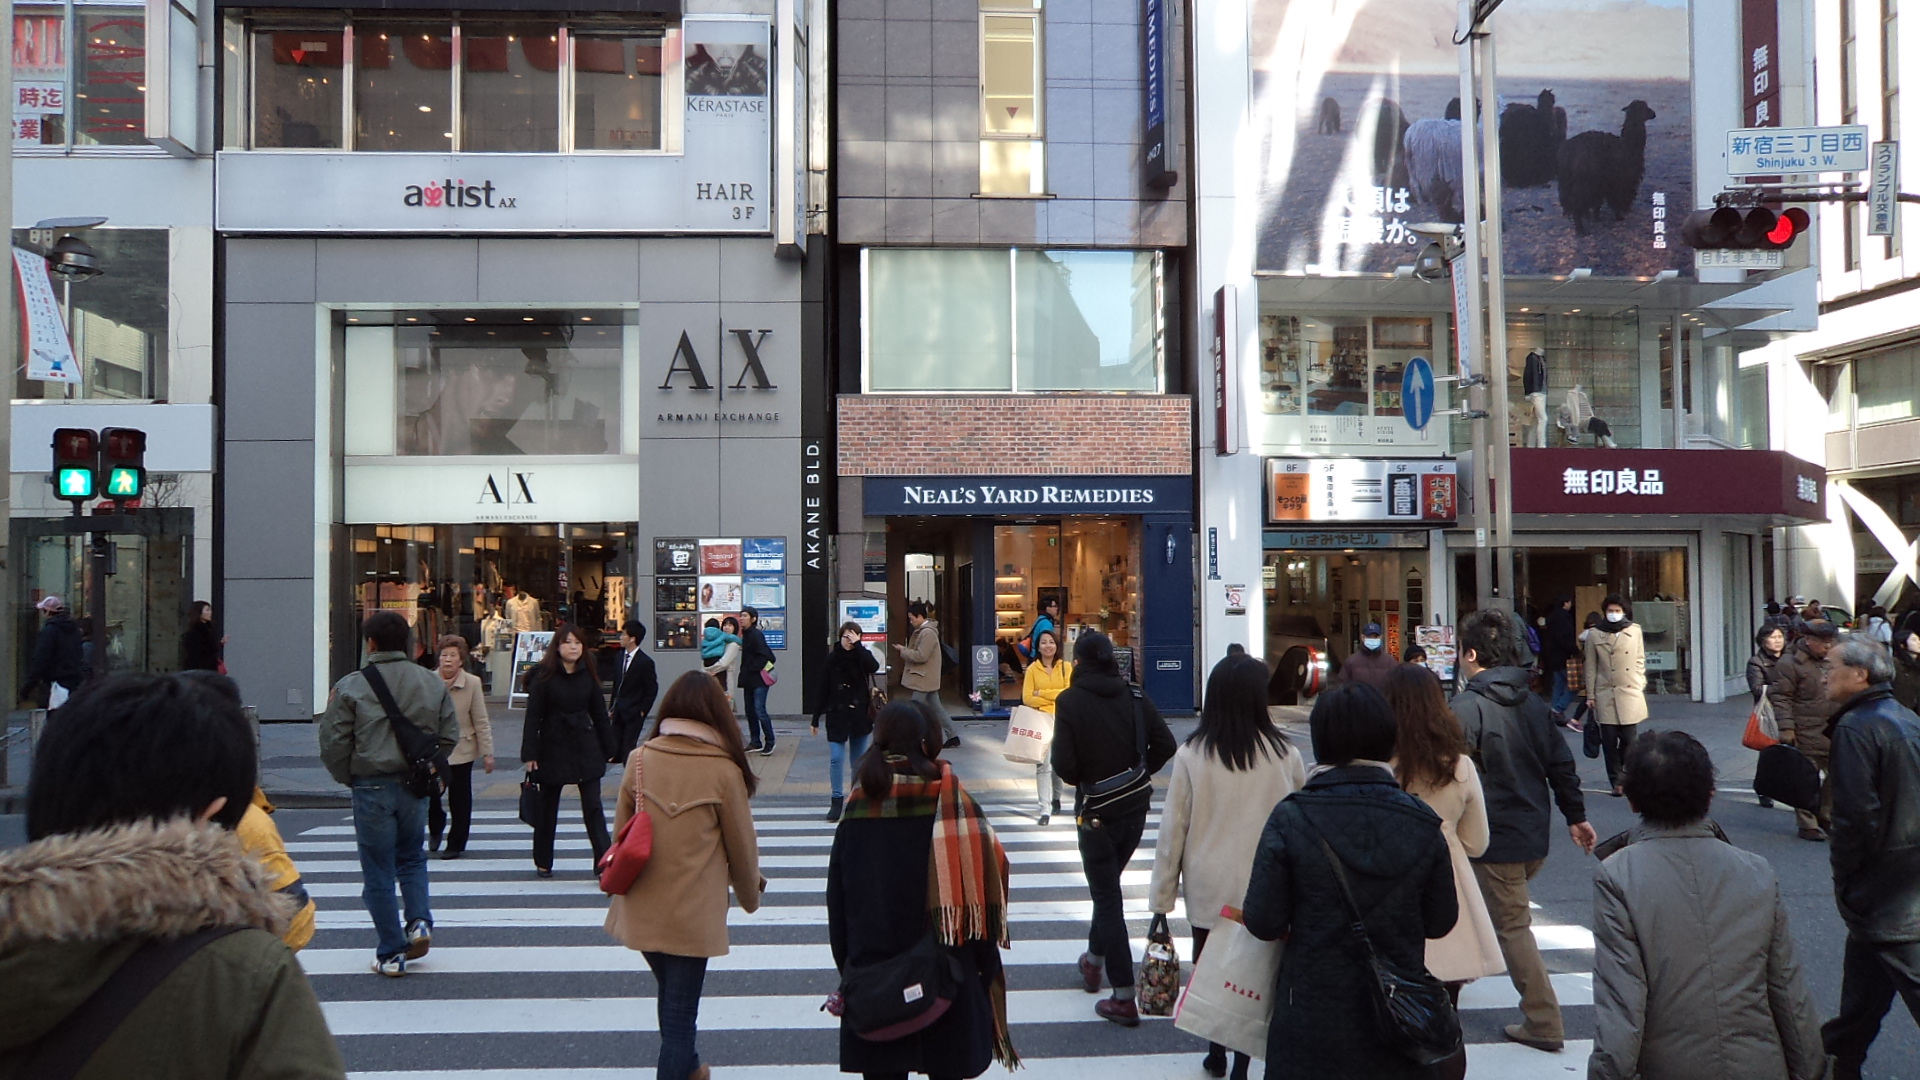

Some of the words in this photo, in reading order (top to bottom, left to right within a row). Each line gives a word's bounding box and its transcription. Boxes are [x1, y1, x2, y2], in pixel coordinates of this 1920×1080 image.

[1753, 44, 1770, 128] 無印良
[687, 96, 764, 113] KÉRASTASE
[12, 119, 39, 140] 業
[1731, 132, 1864, 156] 新宿三丁目西
[1756, 157, 1805, 169] Shinjuku
[1810, 156, 1817, 166] 3
[1822, 155, 1838, 166] W.
[697, 183, 754, 200] HAIR
[1875, 144, 1892, 232] スクランブル交差点
[498, 197, 517, 208] AX
[732, 206, 755, 220] 3F
[1652, 191, 1667, 249] 無印良品
[1701, 250, 1778, 265] 自転車専用
[657, 412, 708, 422] ARMANI
[714, 412, 780, 421] EXCHANGE
[807, 440, 820, 484] BLD.
[1286, 463, 1298, 472] 8F
[1396, 464, 1407, 473] 5F
[1432, 464, 1444, 472] 4F
[1563, 467, 1664, 495] 無印良品
[1430, 478, 1448, 518] 北海道
[807, 497, 820, 569] AKANE
[1290, 533, 1379, 546] いさみやビル
[1011, 726, 1043, 741] 無印良品
[1224, 981, 1262, 1001] PLAZA
